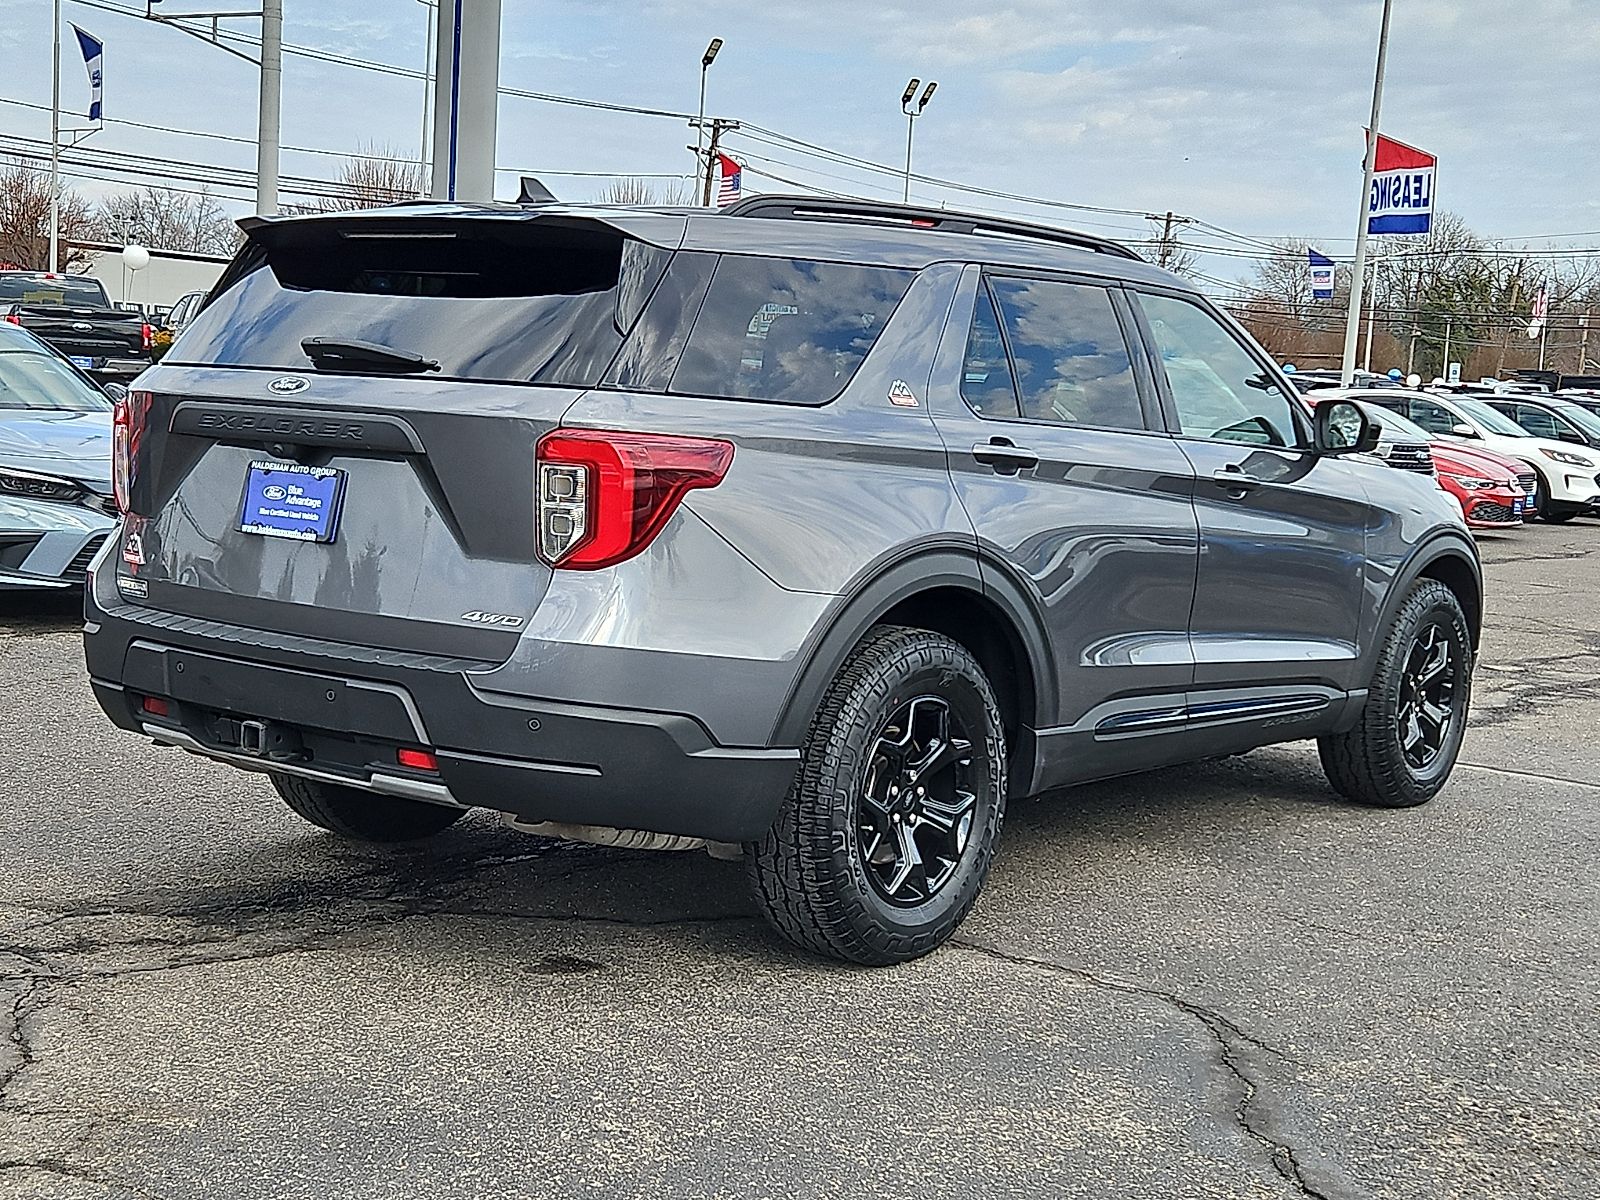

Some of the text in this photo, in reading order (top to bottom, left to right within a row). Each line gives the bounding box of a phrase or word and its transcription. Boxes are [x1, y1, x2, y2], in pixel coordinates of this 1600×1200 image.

[270, 377, 305, 391] Ford
[198, 413, 366, 440] EXPLORER
[251, 461, 337, 477] HALDEMAN AUTO GROUP
[265, 486, 285, 499] Ford
[287, 485, 304, 495] Blue
[285, 495, 322, 508] Advantage
[461, 611, 524, 626] 4WD
